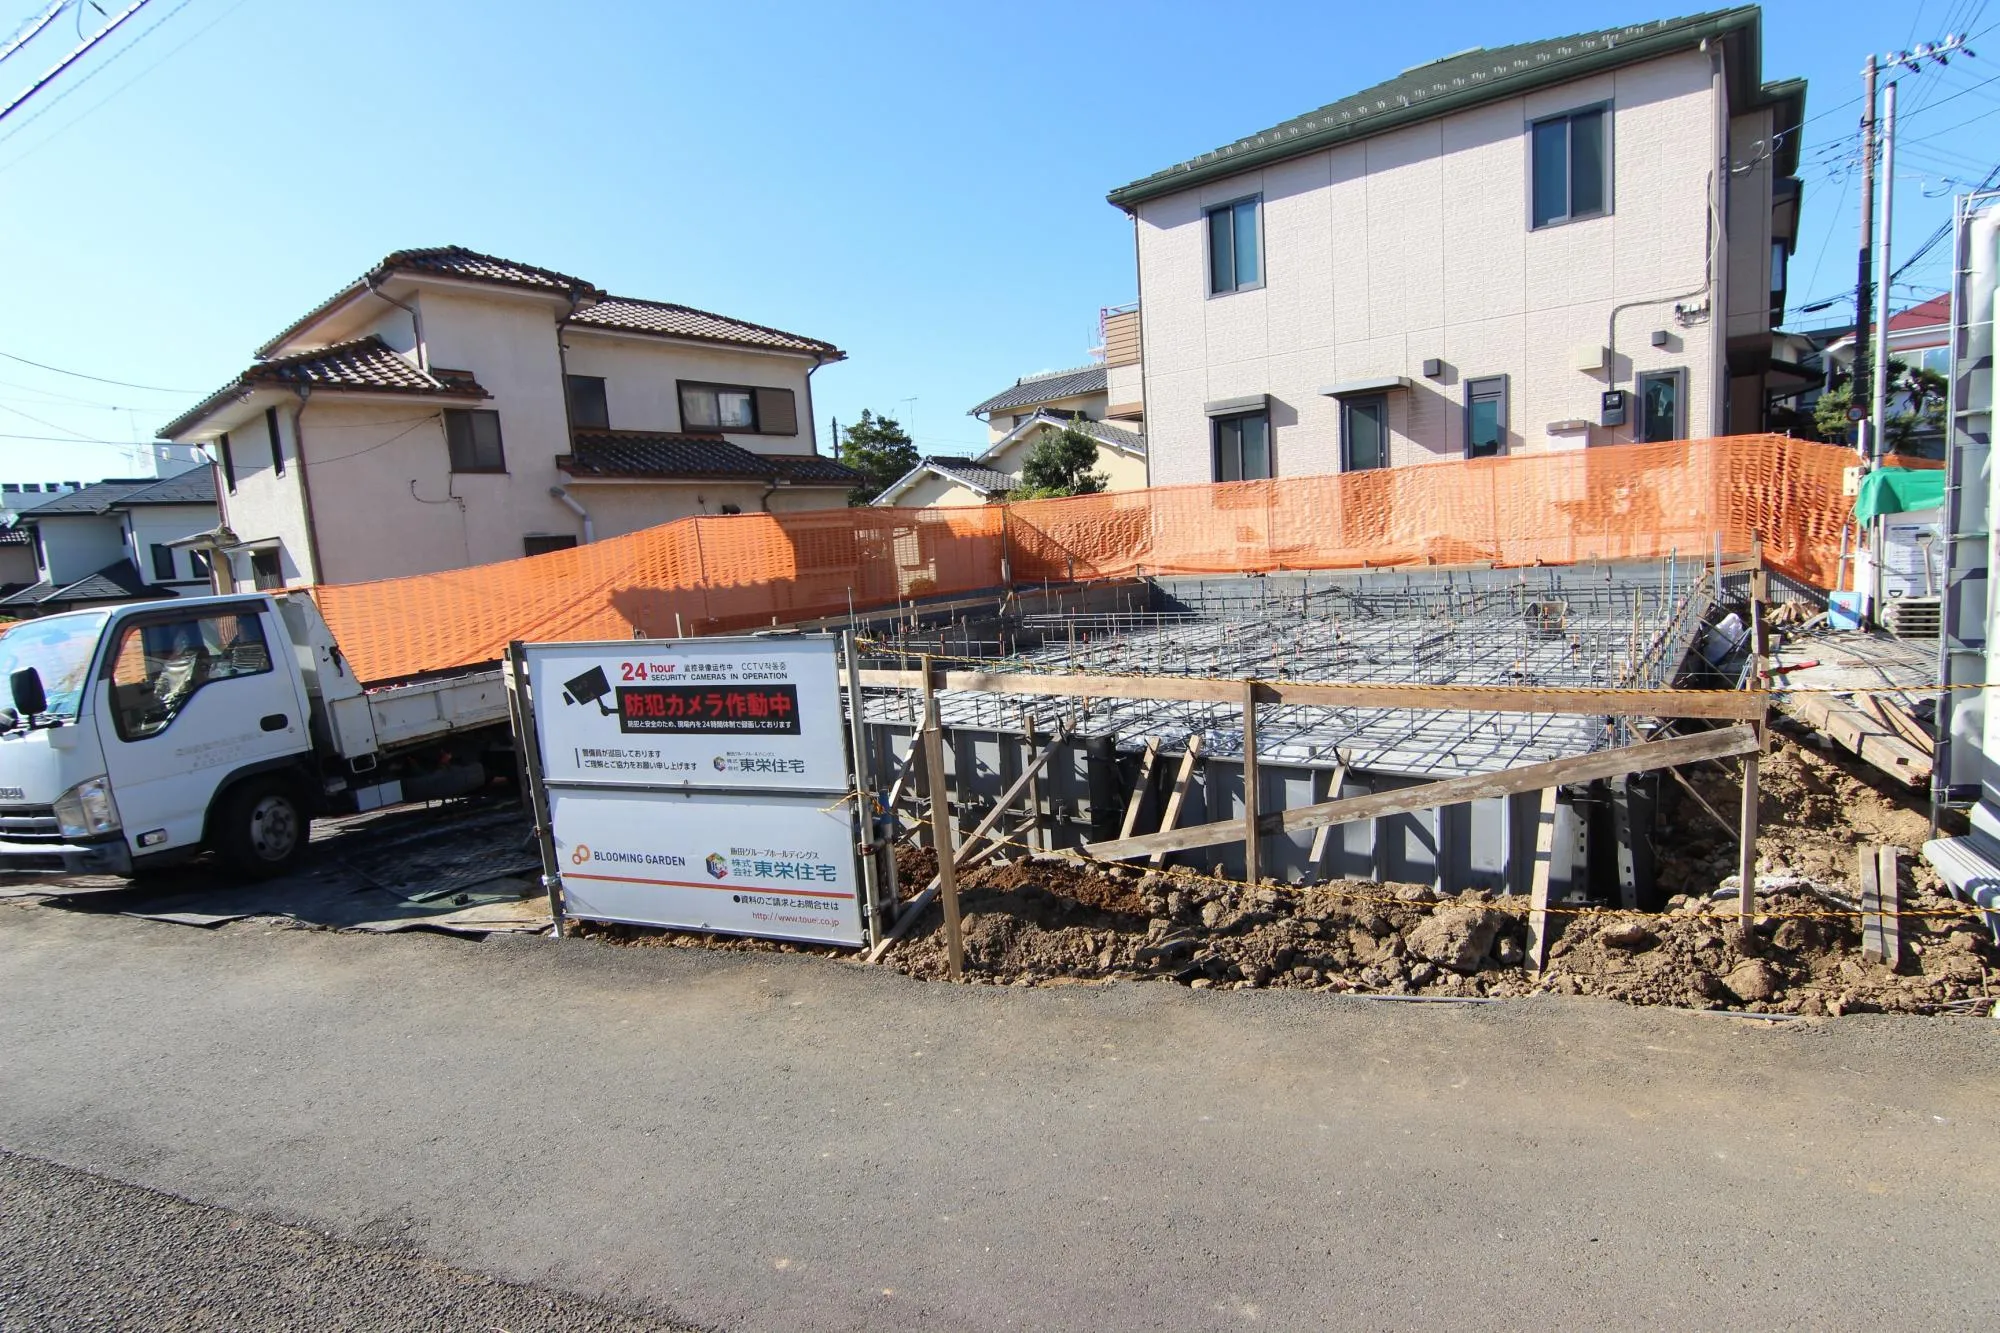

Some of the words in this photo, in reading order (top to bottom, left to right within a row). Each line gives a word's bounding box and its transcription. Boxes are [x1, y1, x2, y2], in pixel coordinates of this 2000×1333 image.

[621, 662, 647, 681] 24
[650, 662, 676, 673] hour
[651, 673, 687, 681] SECURITY
[691, 673, 727, 681] CAMERAS
[742, 672, 788, 680] OPERATION
[624, 693, 792, 717] 防犯カメラ作動中
[739, 758, 805, 773] 東栄住宅
[594, 851, 644, 864] BLOOMING
[645, 854, 686, 866] GARDEN
[753, 861, 837, 882] 東栄住宅
[752, 911, 840, 927] http://www.toue.co.jp
